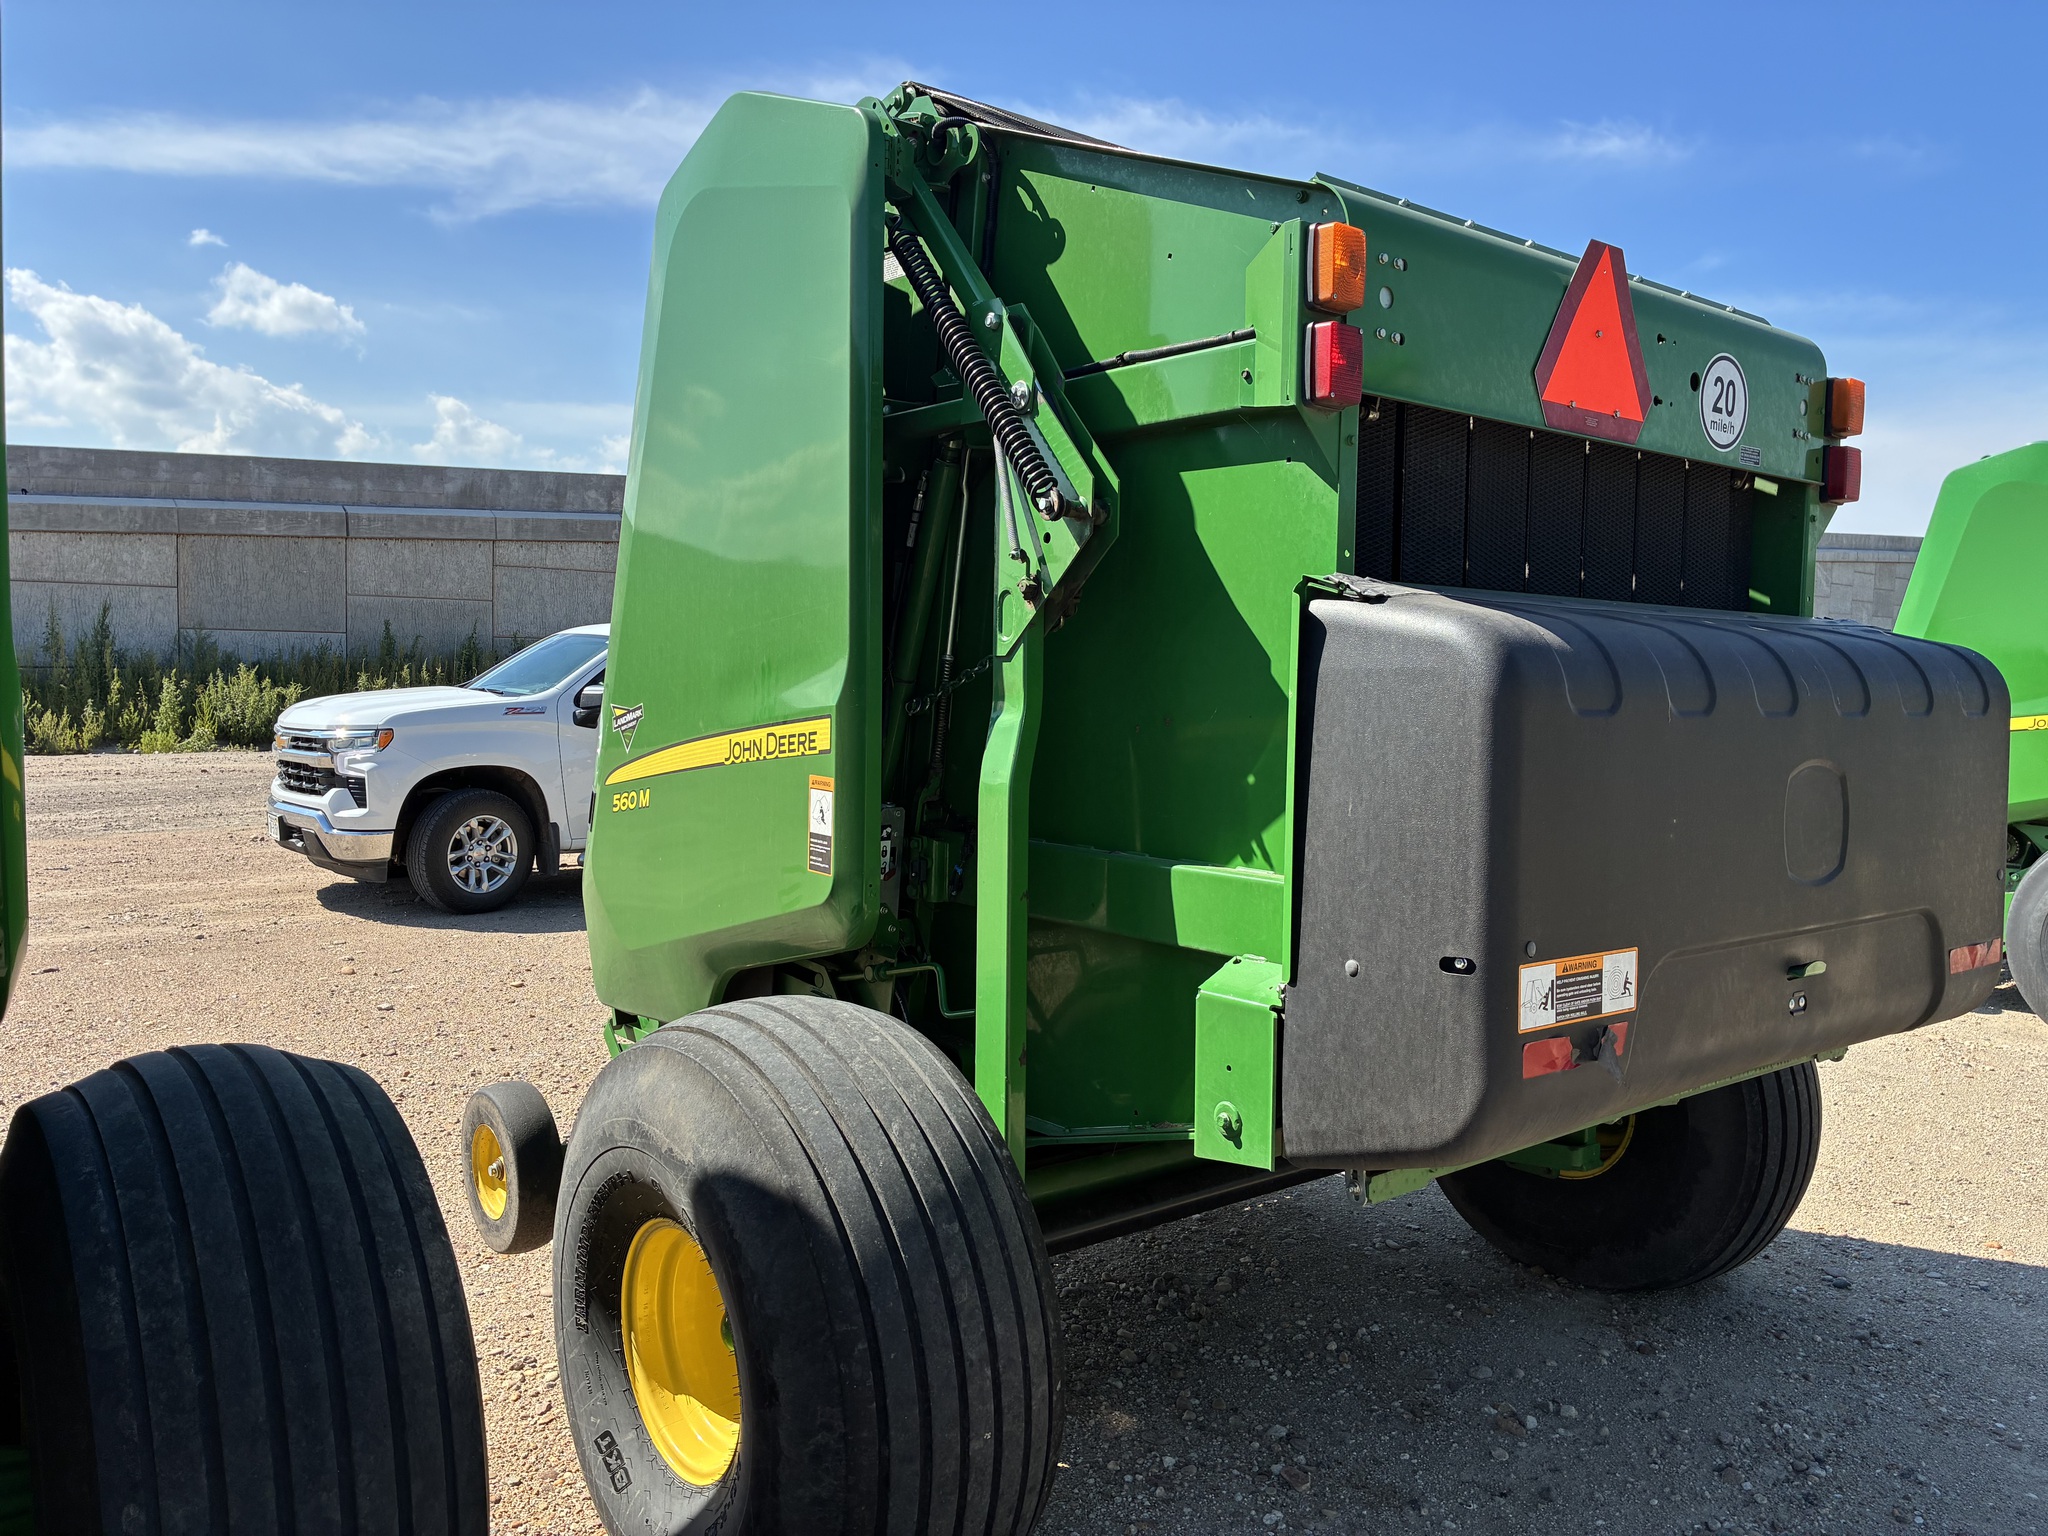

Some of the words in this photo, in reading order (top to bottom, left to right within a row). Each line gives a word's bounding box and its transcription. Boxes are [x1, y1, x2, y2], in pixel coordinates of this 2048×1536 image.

[1712, 376, 1736, 417] 20
[1710, 419, 1735, 435] mile/h
[2027, 718, 2048, 728] JO
[724, 738, 762, 762] JOHN
[766, 731, 818, 755] DEERE
[612, 790, 637, 812] 560
[639, 788, 650, 808] M
[1569, 960, 1597, 972] WARNING
[574, 1267, 589, 1334] FARM
[595, 1431, 631, 1492] BKT
